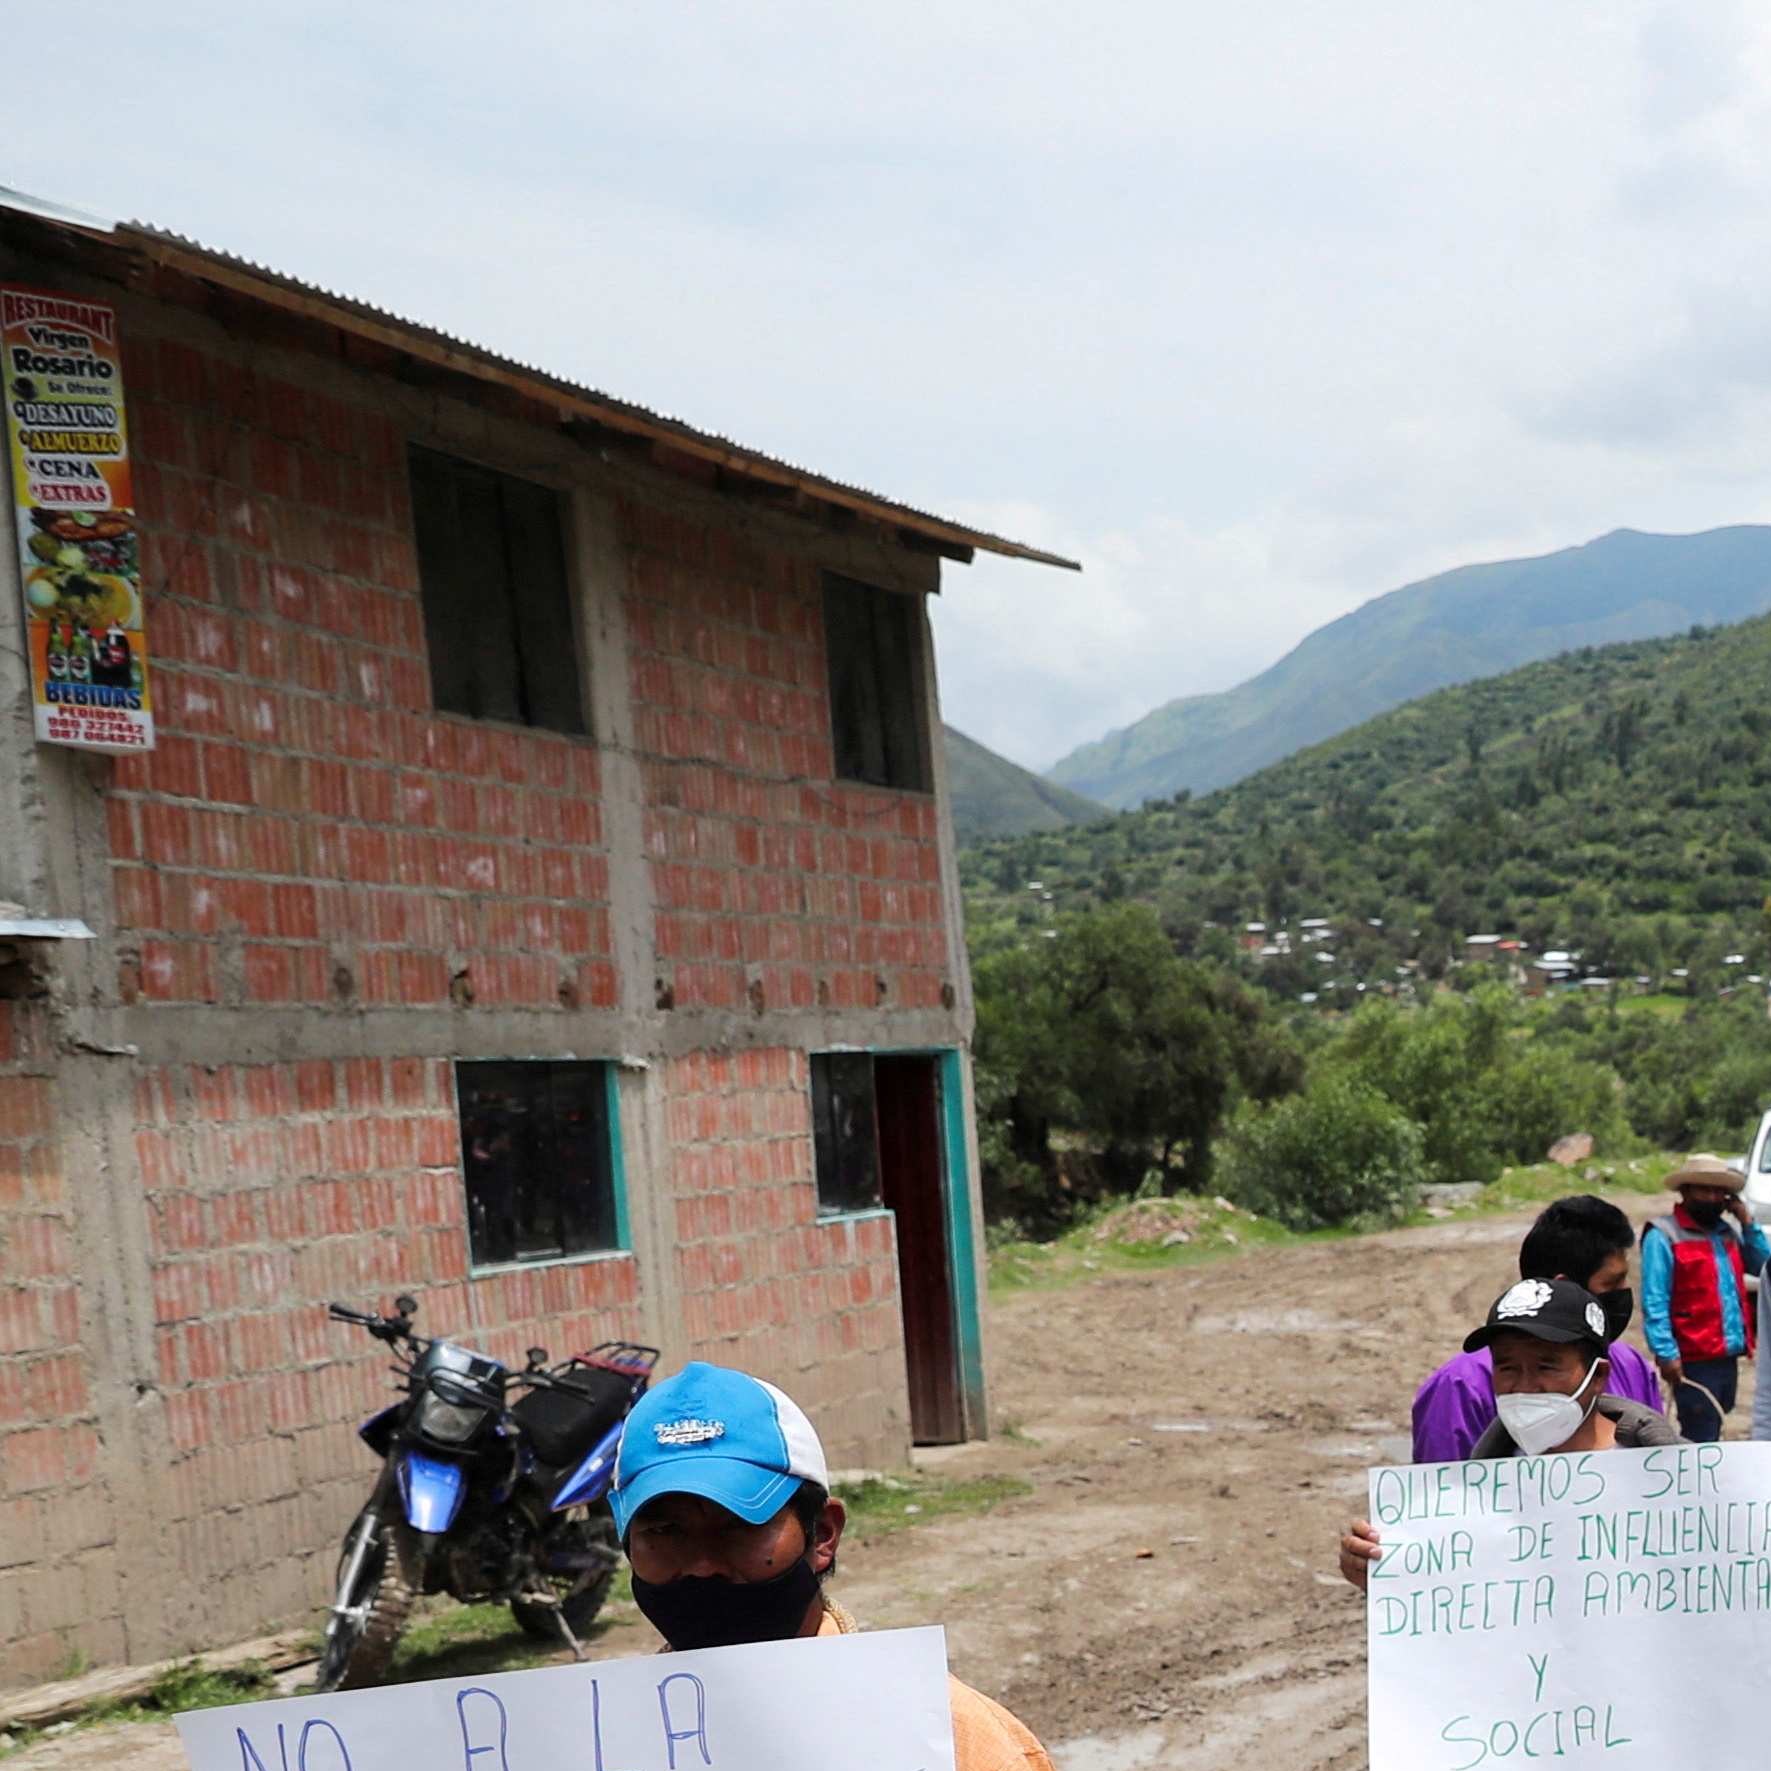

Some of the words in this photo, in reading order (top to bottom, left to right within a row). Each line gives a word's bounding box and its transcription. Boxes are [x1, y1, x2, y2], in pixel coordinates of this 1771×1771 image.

[3, 295, 112, 341] RESTAURANT
[28, 326, 89, 350] Virgen
[12, 347, 114, 379] Rosario
[45, 681, 143, 710] BEBIDAS
[1376, 1453, 1606, 1526] QUEREMOS
[1641, 1444, 1725, 1499] SER
[1370, 1529, 1475, 1580] ZONA
[1507, 1521, 1554, 1563] DE
[1377, 1575, 1556, 1637] DIRECTA
[1526, 1653, 1549, 1702] Y
[1441, 1705, 1633, 1771] SOCIAL
